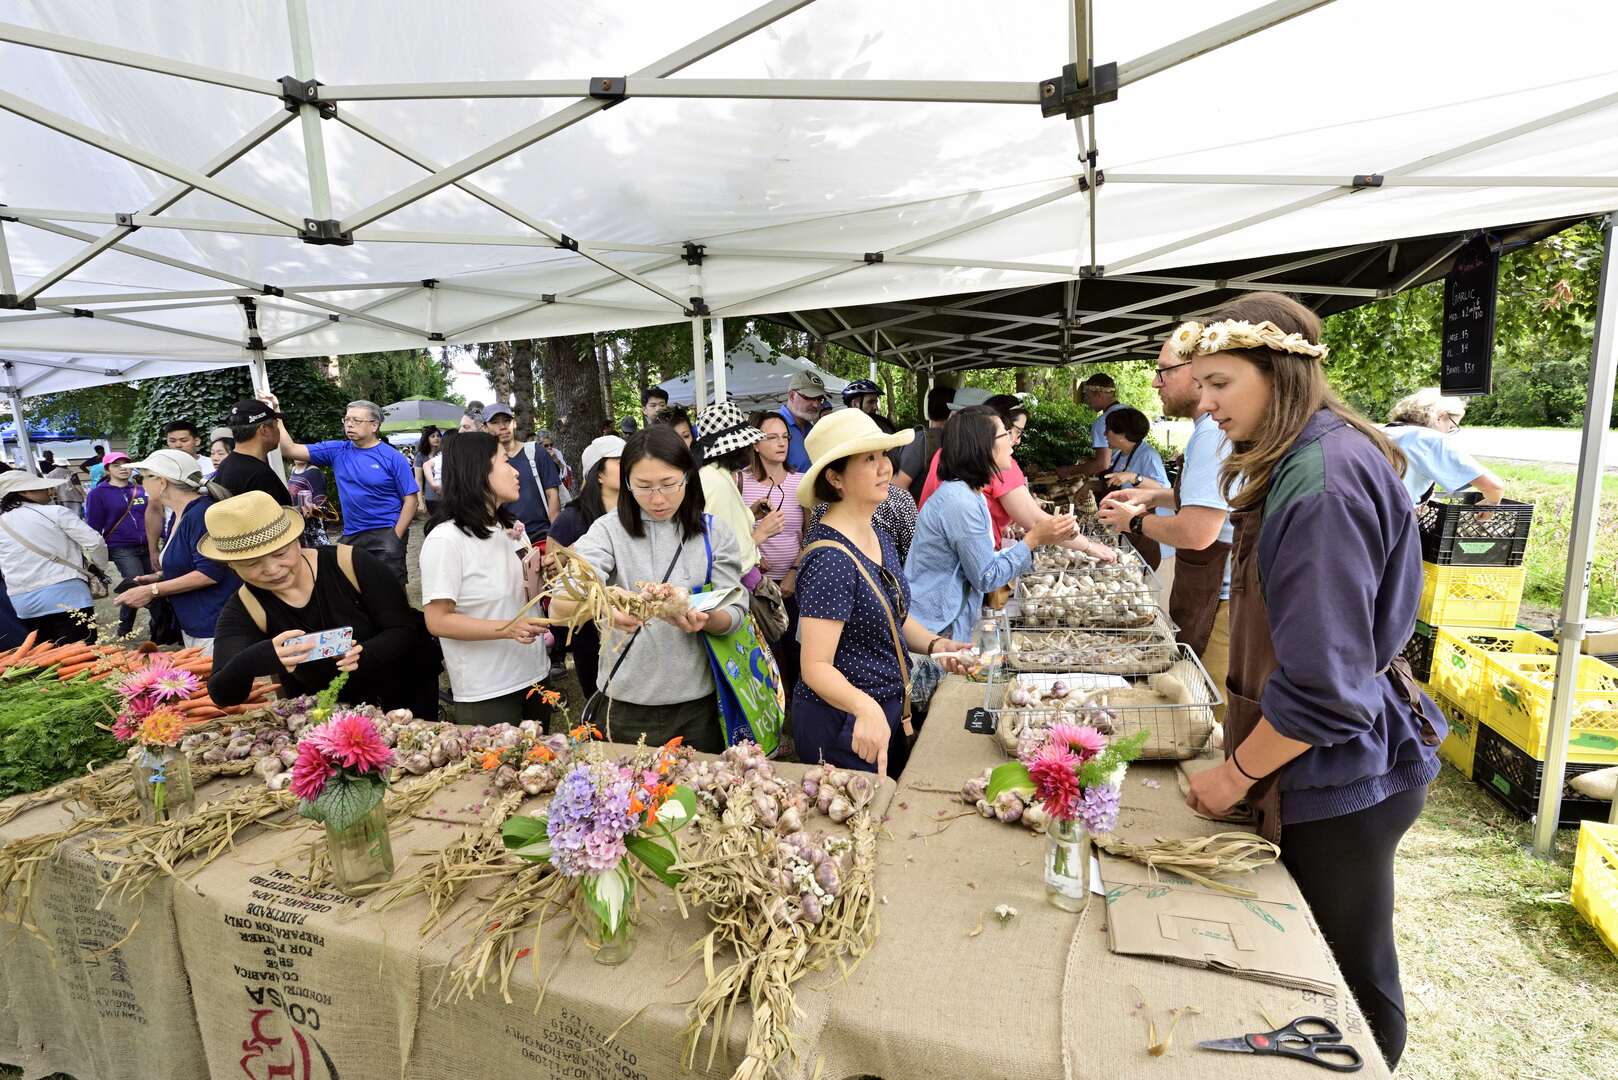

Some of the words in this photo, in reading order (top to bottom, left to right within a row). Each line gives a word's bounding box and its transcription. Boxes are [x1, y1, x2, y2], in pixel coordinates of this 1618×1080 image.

[279, 897, 332, 913] ORGANIC
[224, 914, 252, 929] ONLY
[246, 902, 307, 925] FAIRTRADE
